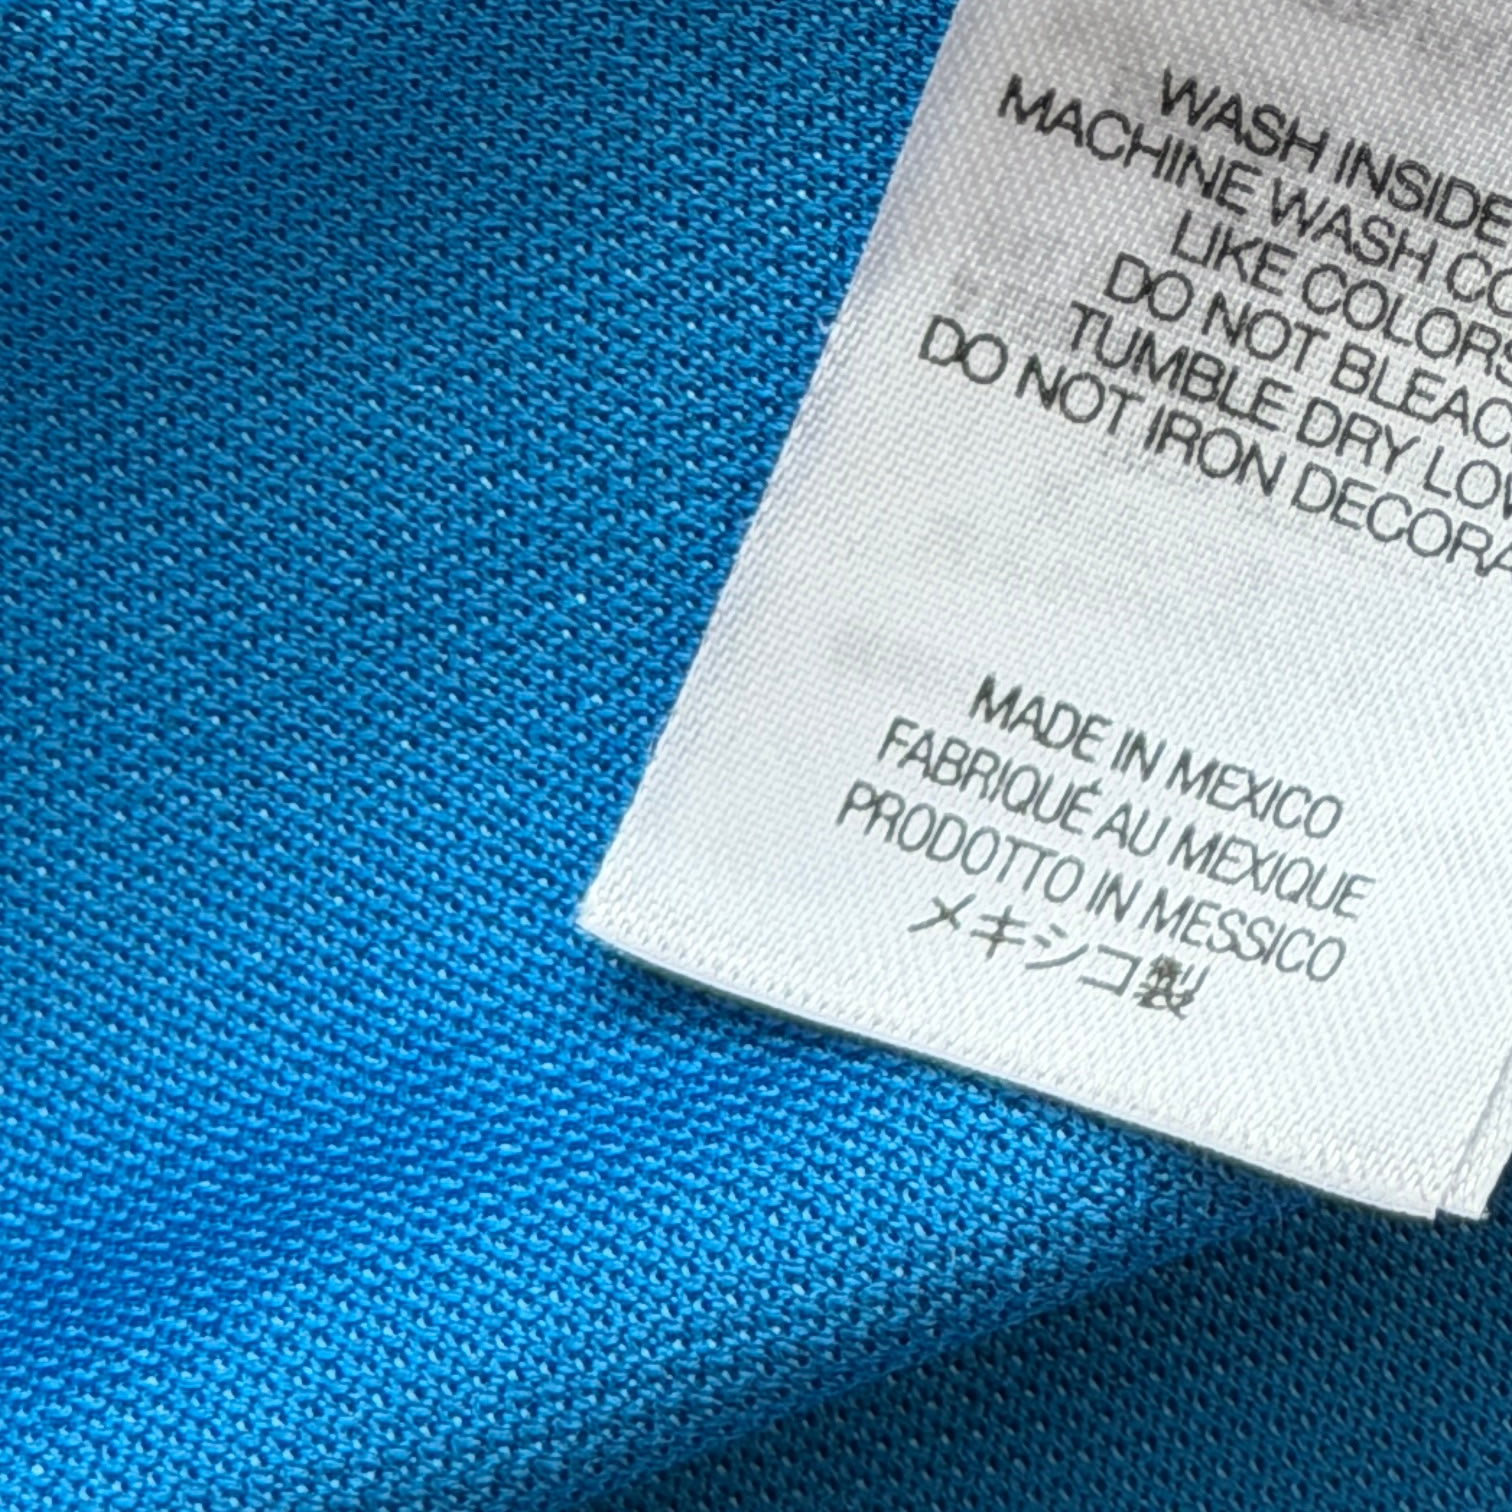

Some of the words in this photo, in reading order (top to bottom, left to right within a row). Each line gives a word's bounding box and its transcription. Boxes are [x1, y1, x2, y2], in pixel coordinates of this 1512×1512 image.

[996, 72, 1264, 217] MACHINE
[1269, 176, 1439, 285] WASH
[1159, 66, 1332, 175] WASH
[1101, 250, 1196, 324] DO
[1200, 290, 1331, 374] NOT
[1168, 209, 1299, 298] LIKE
[917, 313, 1010, 386] DO
[1013, 352, 1146, 437] NOT
[1141, 404, 1288, 499] IRON
[1068, 299, 1295, 433] TUMBLE
[1294, 395, 1422, 477] DRY
[876, 715, 1103, 836] FABRIQUÉ
[1091, 801, 1172, 858] AU
[1166, 822, 1376, 920] MEXIQUE
[967, 673, 1114, 764] MADE
[1109, 728, 1168, 784] IN
[1164, 747, 1345, 840] MEXICO
[834, 778, 1086, 905] PRODOTTO
[1084, 868, 1144, 925] IN
[1137, 886, 1348, 984] MESSICO
[906, 893, 1211, 1022] メキシコ製
